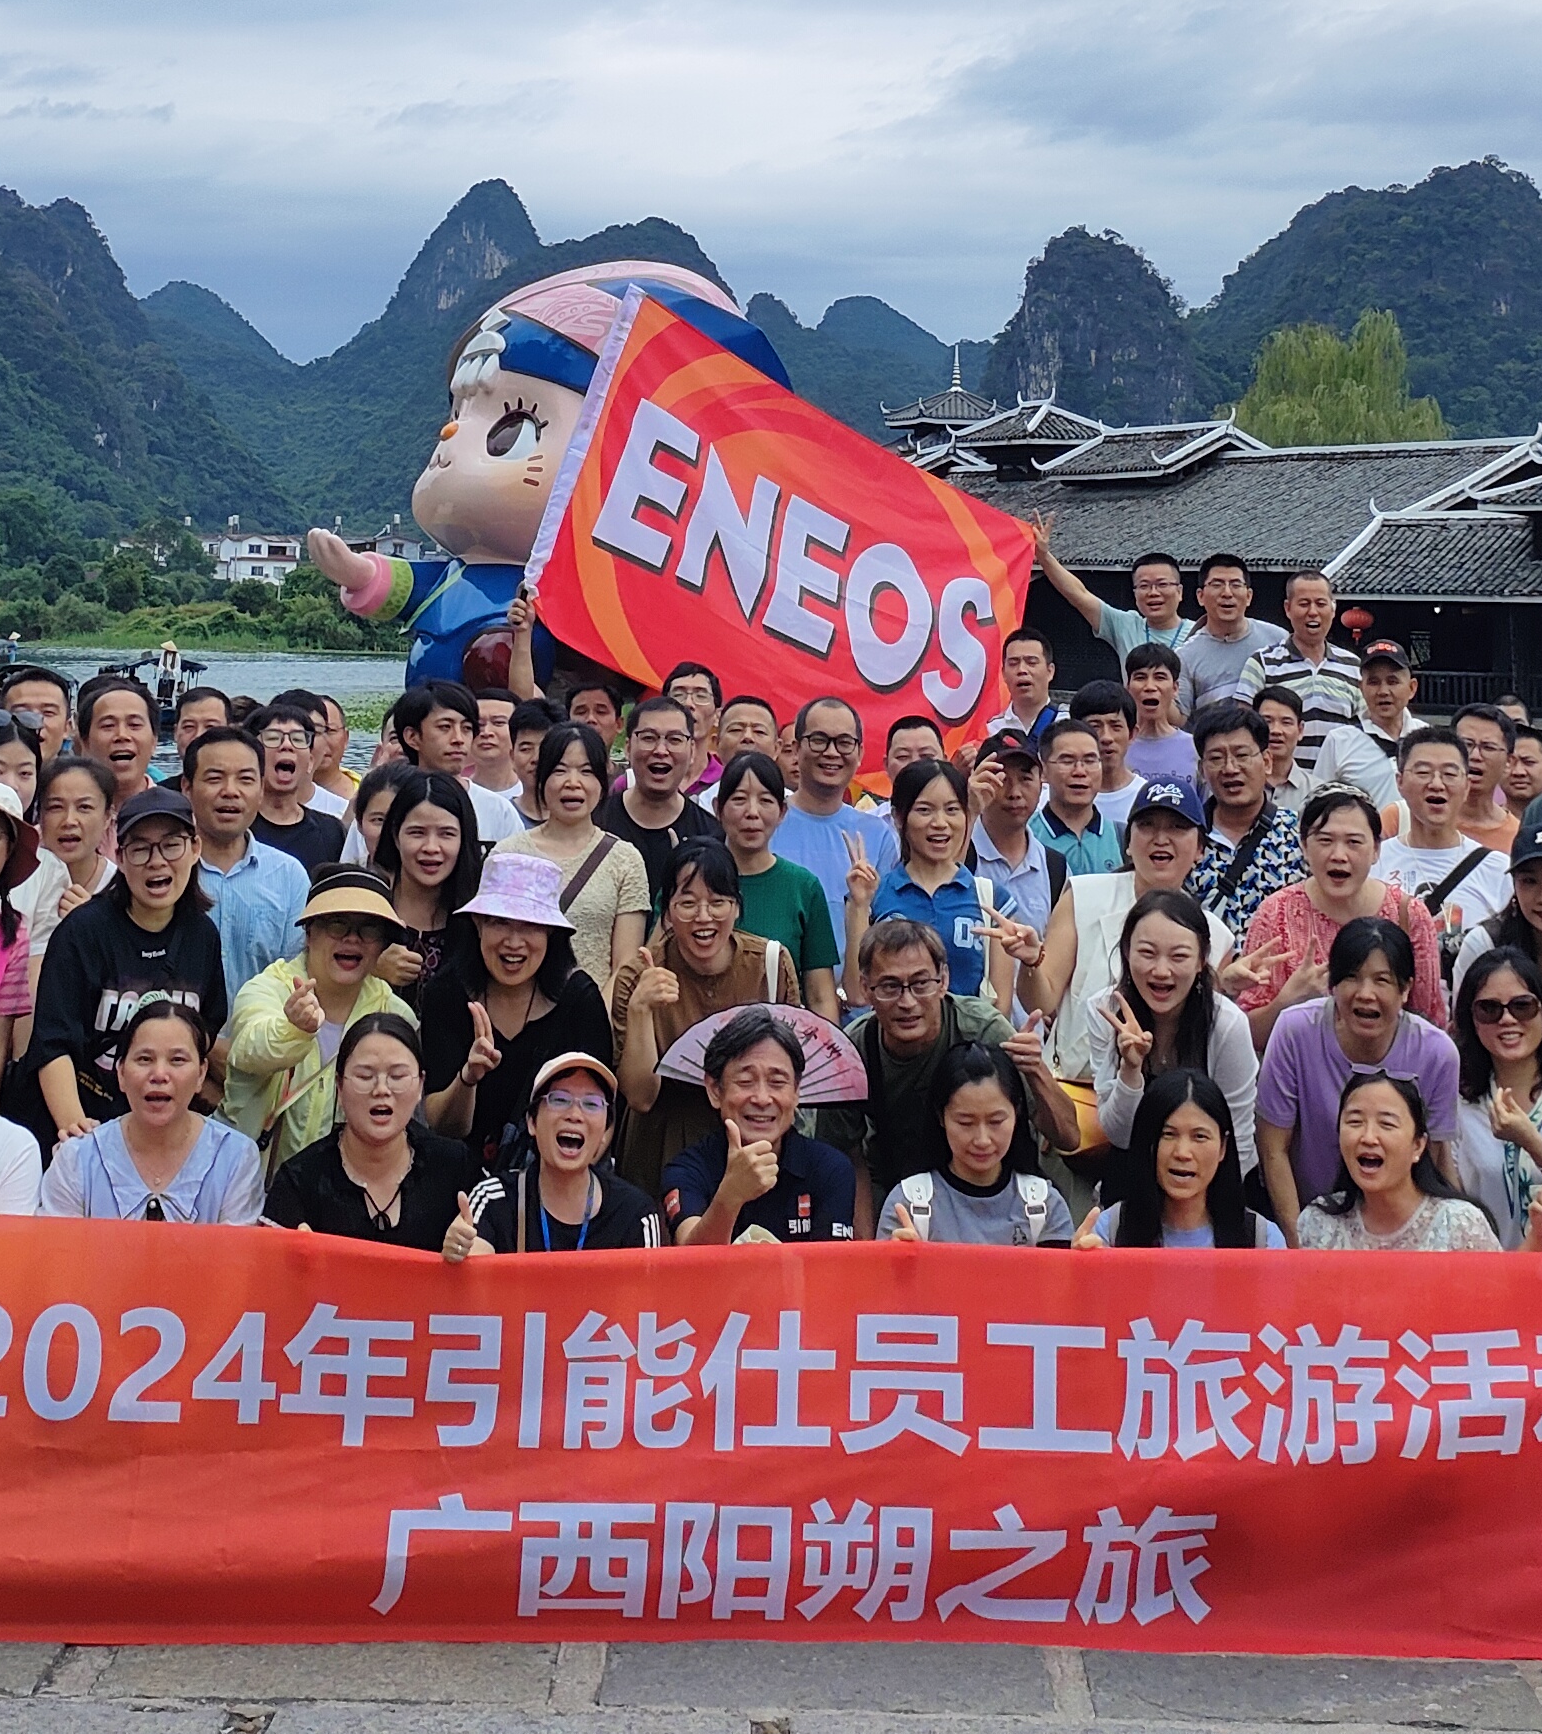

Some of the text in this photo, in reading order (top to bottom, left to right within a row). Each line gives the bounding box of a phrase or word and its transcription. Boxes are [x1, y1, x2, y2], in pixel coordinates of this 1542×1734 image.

[591, 397, 996, 721] ENEOS
[1146, 783, 1183, 800] Polo
[368, 1492, 1218, 1627] 广西阳朔之旅
